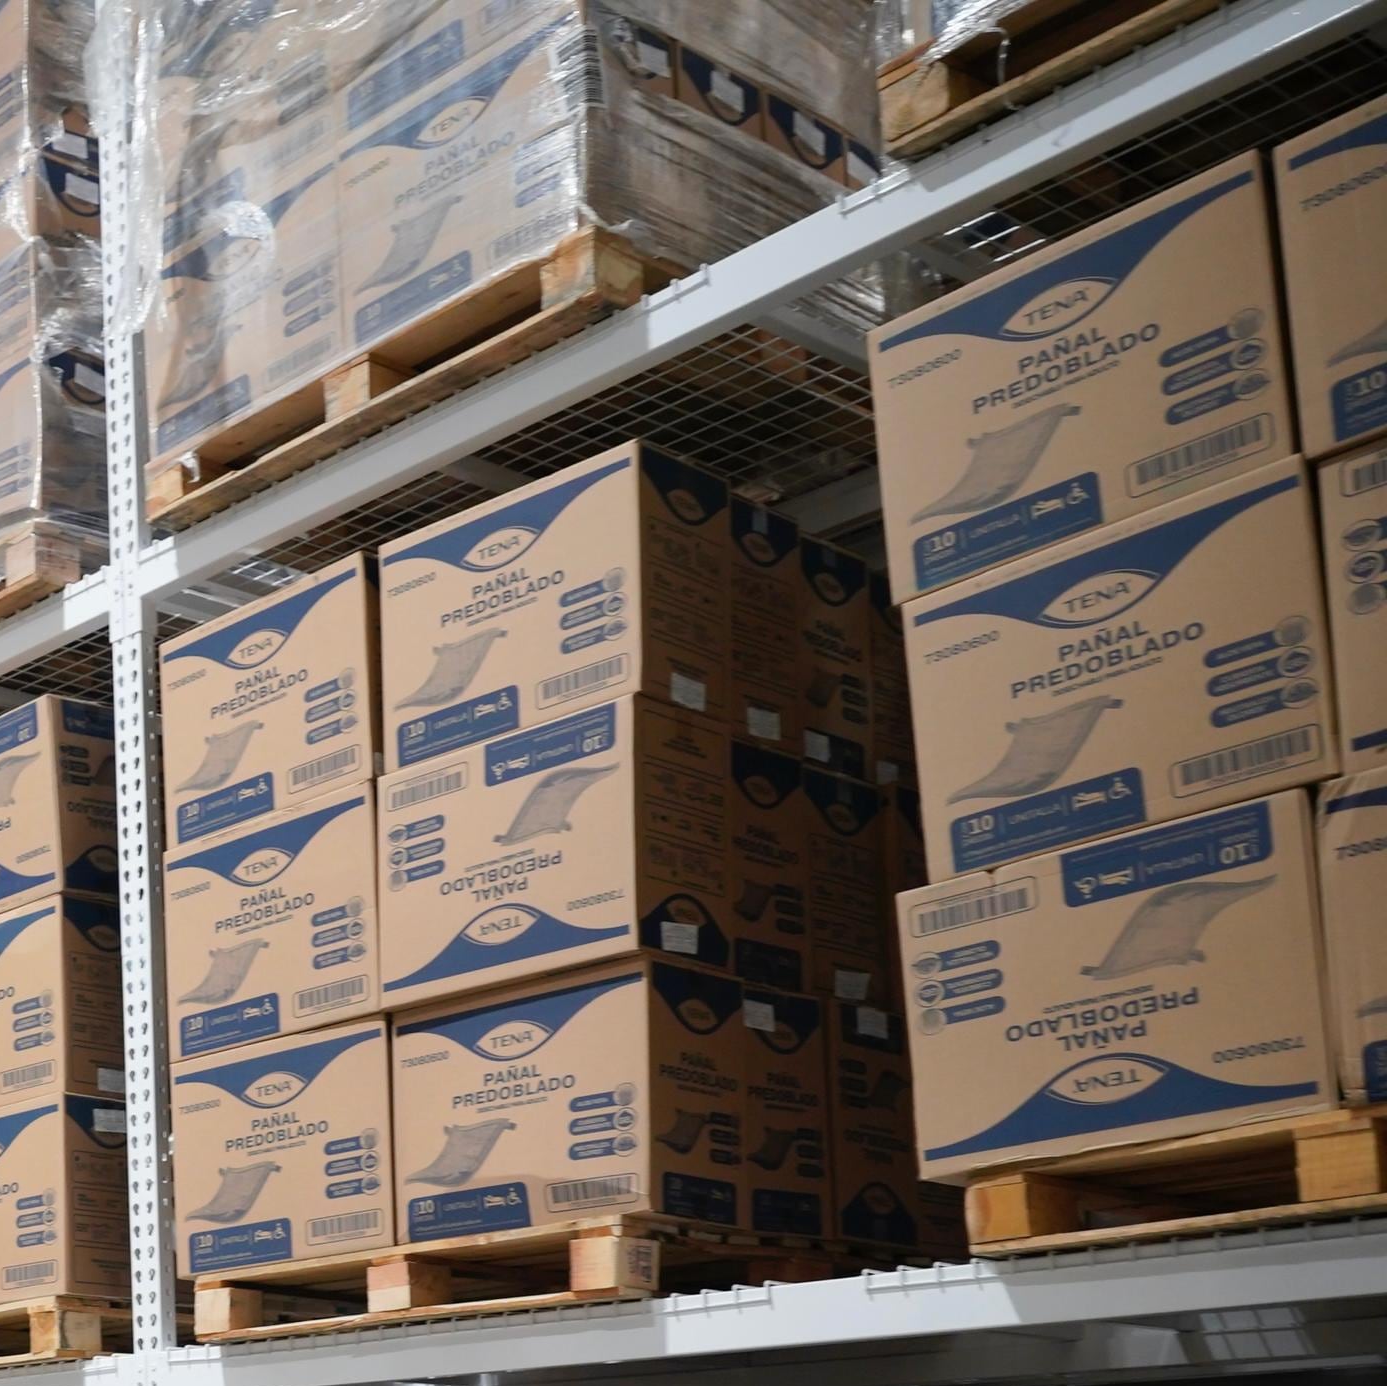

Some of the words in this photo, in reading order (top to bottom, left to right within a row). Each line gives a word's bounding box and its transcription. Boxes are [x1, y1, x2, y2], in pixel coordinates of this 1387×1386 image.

[1026, 288, 1088, 326] TENA
[1017, 326, 1104, 374] PAÑAL
[972, 324, 1160, 412] PREDOBLADO
[479, 535, 519, 560] TENA
[932, 529, 955, 553] 10
[472, 567, 528, 599] PAÑAL
[442, 571, 563, 626] PREDOBLADO
[1066, 581, 1129, 613] TENA
[240, 637, 272, 659] TENA
[1058, 620, 1146, 661] PAÑAL
[1011, 623, 1204, 697] PREDOBLADO
[235, 665, 279, 693] PAÑAL
[211, 669, 308, 718] PREDOBLADO
[409, 720, 424, 737] 10
[583, 734, 600, 752] 10
[969, 813, 994, 835] 10
[1219, 841, 1248, 864] 10
[244, 856, 277, 876] TENA
[440, 851, 559, 894] PREDOBLADO
[240, 886, 285, 910] PAÑAL
[472, 877, 526, 902] PAÑAL
[215, 893, 314, 932] PREDOBLADO
[480, 916, 519, 935] TENA
[1002, 988, 1199, 1040] PREDOBLADO
[491, 1030, 532, 1048] TENA
[1057, 1020, 1147, 1051] PAÑAL
[482, 1064, 540, 1086] PAÑAL
[1073, 1068, 1139, 1092] TENA
[257, 1080, 291, 1096] TENA
[451, 1074, 575, 1108] PREDOBLADO
[252, 1111, 298, 1131] PAÑAL
[225, 1121, 328, 1151] PREDOBLADO
[418, 1199, 434, 1214] 10
[199, 1234, 212, 1248] 10
